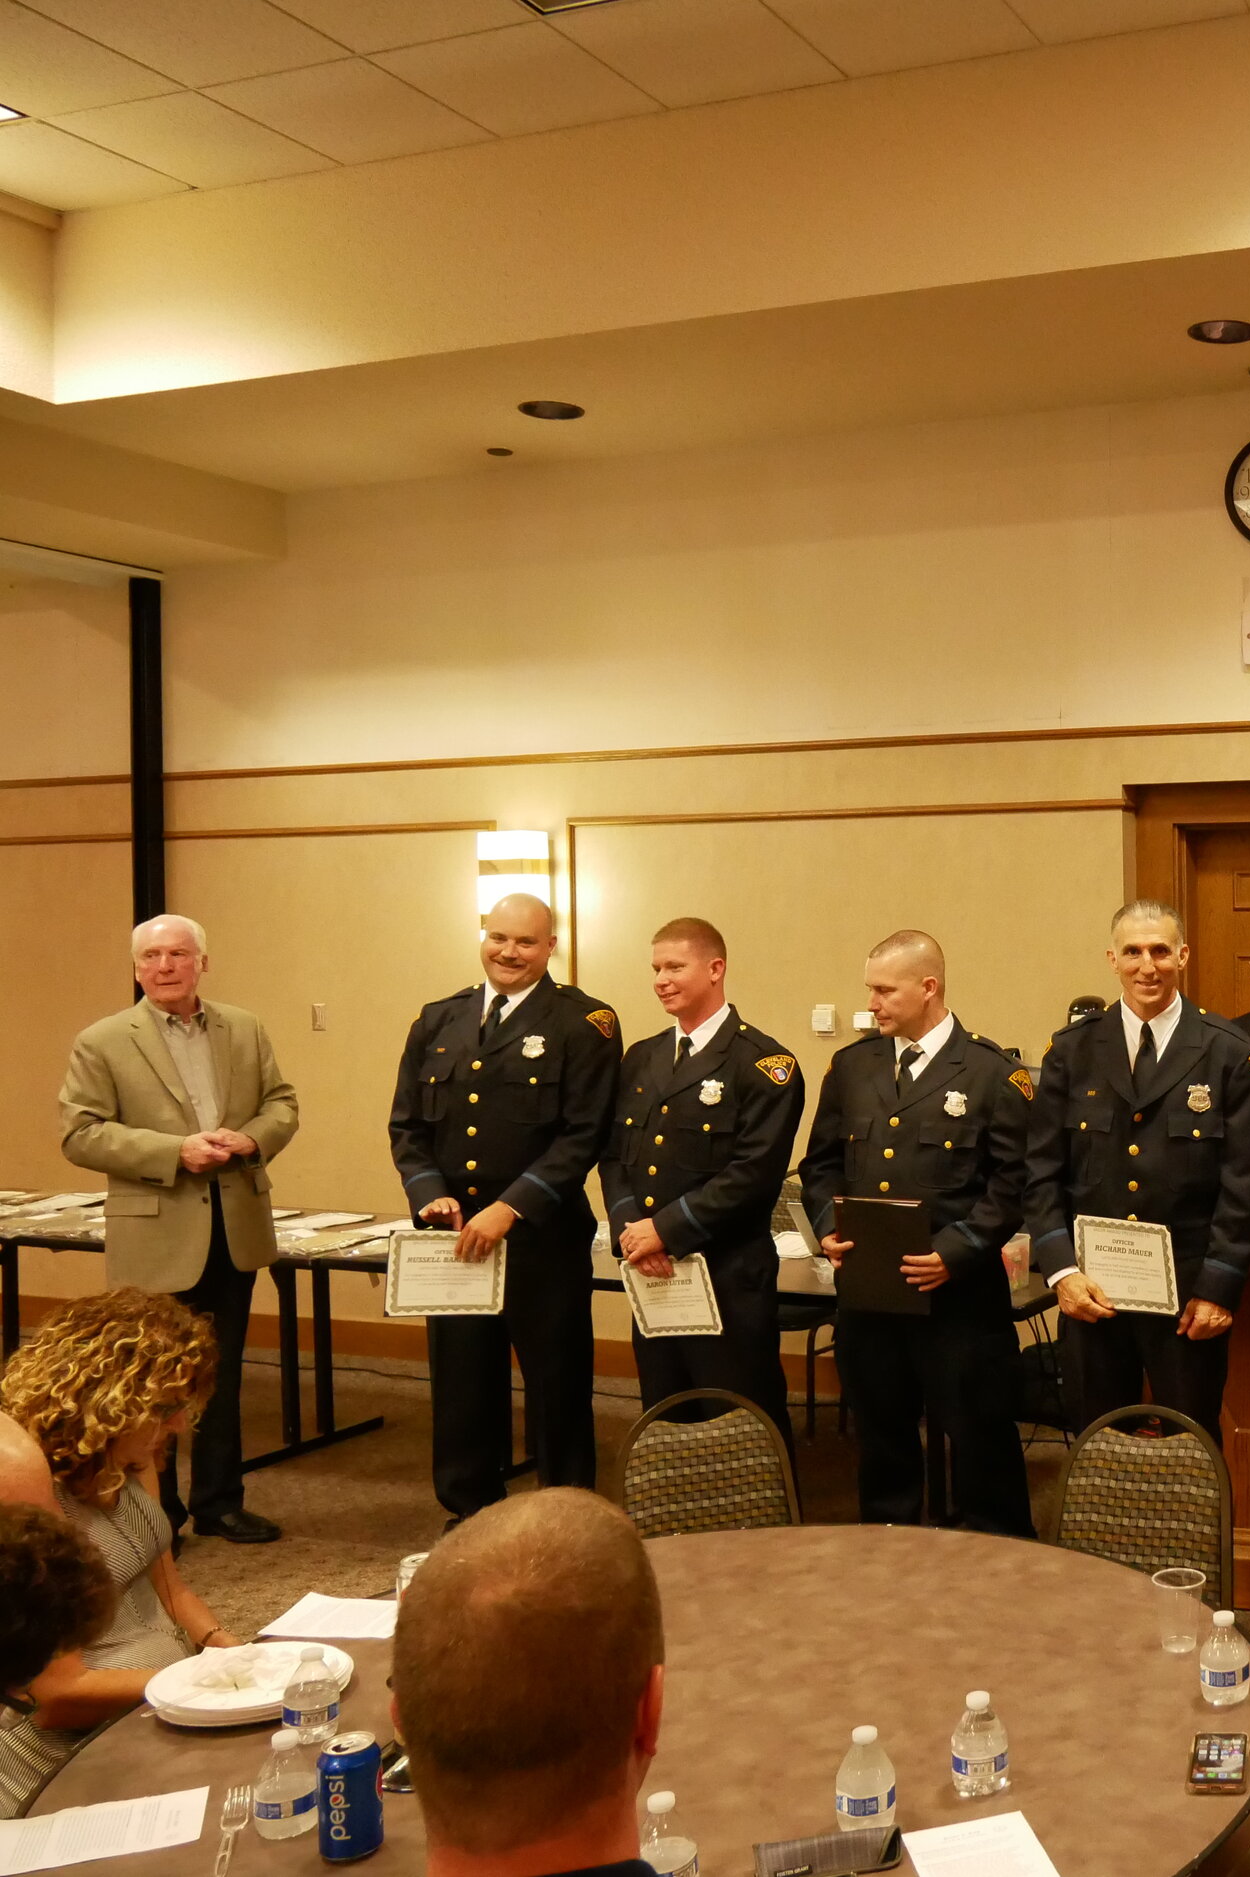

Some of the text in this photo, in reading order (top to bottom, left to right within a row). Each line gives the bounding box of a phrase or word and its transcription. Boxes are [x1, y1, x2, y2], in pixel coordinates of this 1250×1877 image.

[1240, 486, 1249, 500] 9
[1095, 1244, 1153, 1257] RICHARD MAUER
[406, 1256, 441, 1264] RUSSELL
[325, 1774, 352, 1841] pepsi
